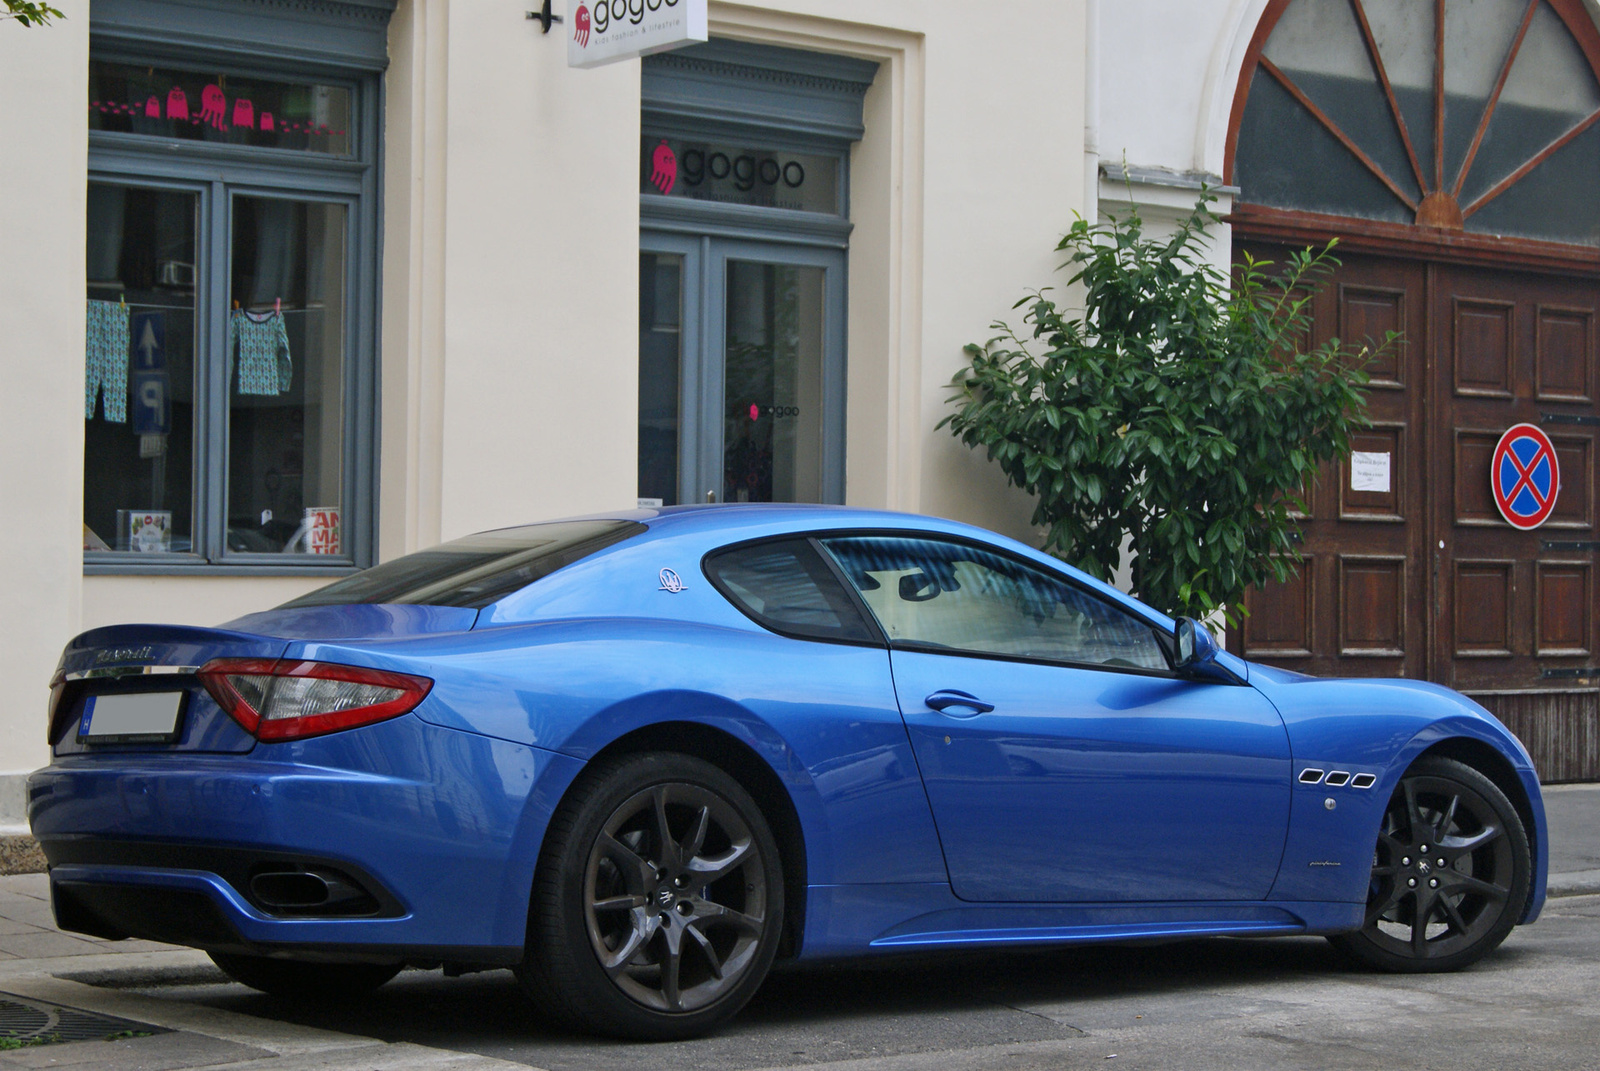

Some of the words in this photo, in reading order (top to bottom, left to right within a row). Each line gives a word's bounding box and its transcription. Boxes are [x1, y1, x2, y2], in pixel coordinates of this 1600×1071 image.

[611, 29, 639, 41] fashion
[641, 26, 647, 34] &
[649, 19, 680, 31] lifestyle
[683, 150, 805, 191] gogoo
